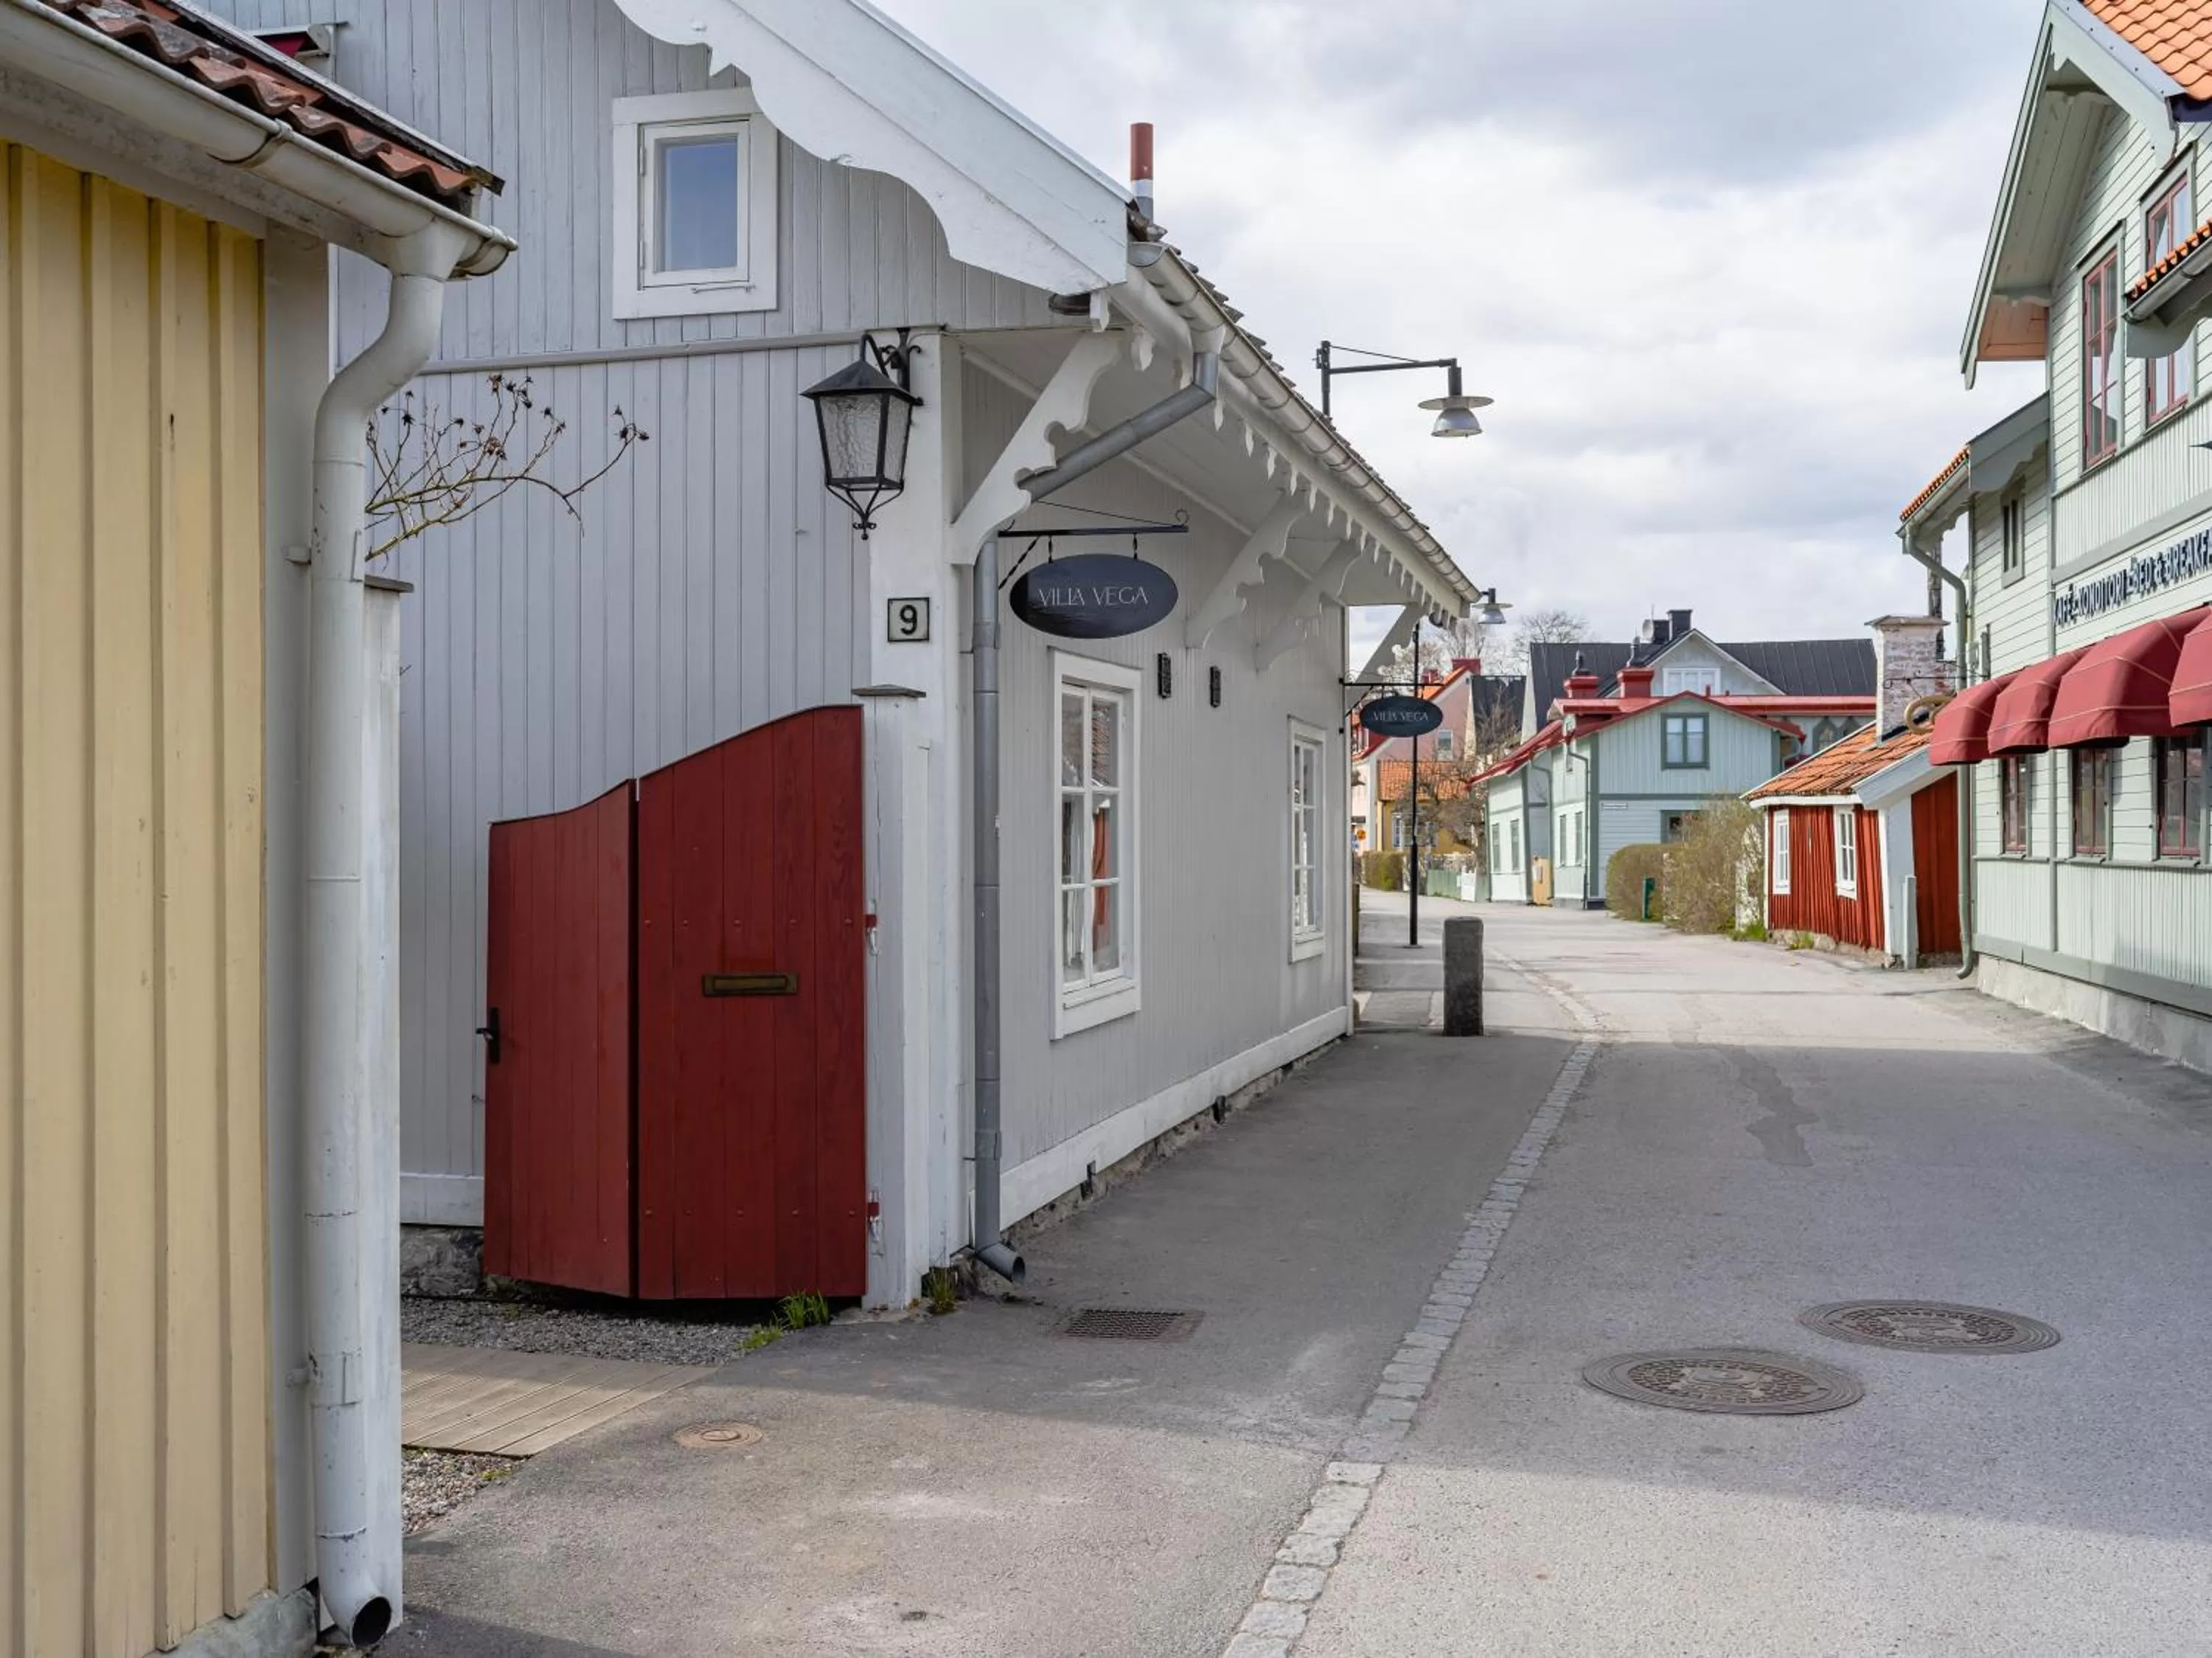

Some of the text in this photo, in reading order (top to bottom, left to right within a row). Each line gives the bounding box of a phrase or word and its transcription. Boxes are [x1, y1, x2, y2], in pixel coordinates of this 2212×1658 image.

[1038, 586, 1150, 607] VILLA VEGA
[900, 604, 918, 636] 9
[1400, 710, 1429, 721] VEGA
